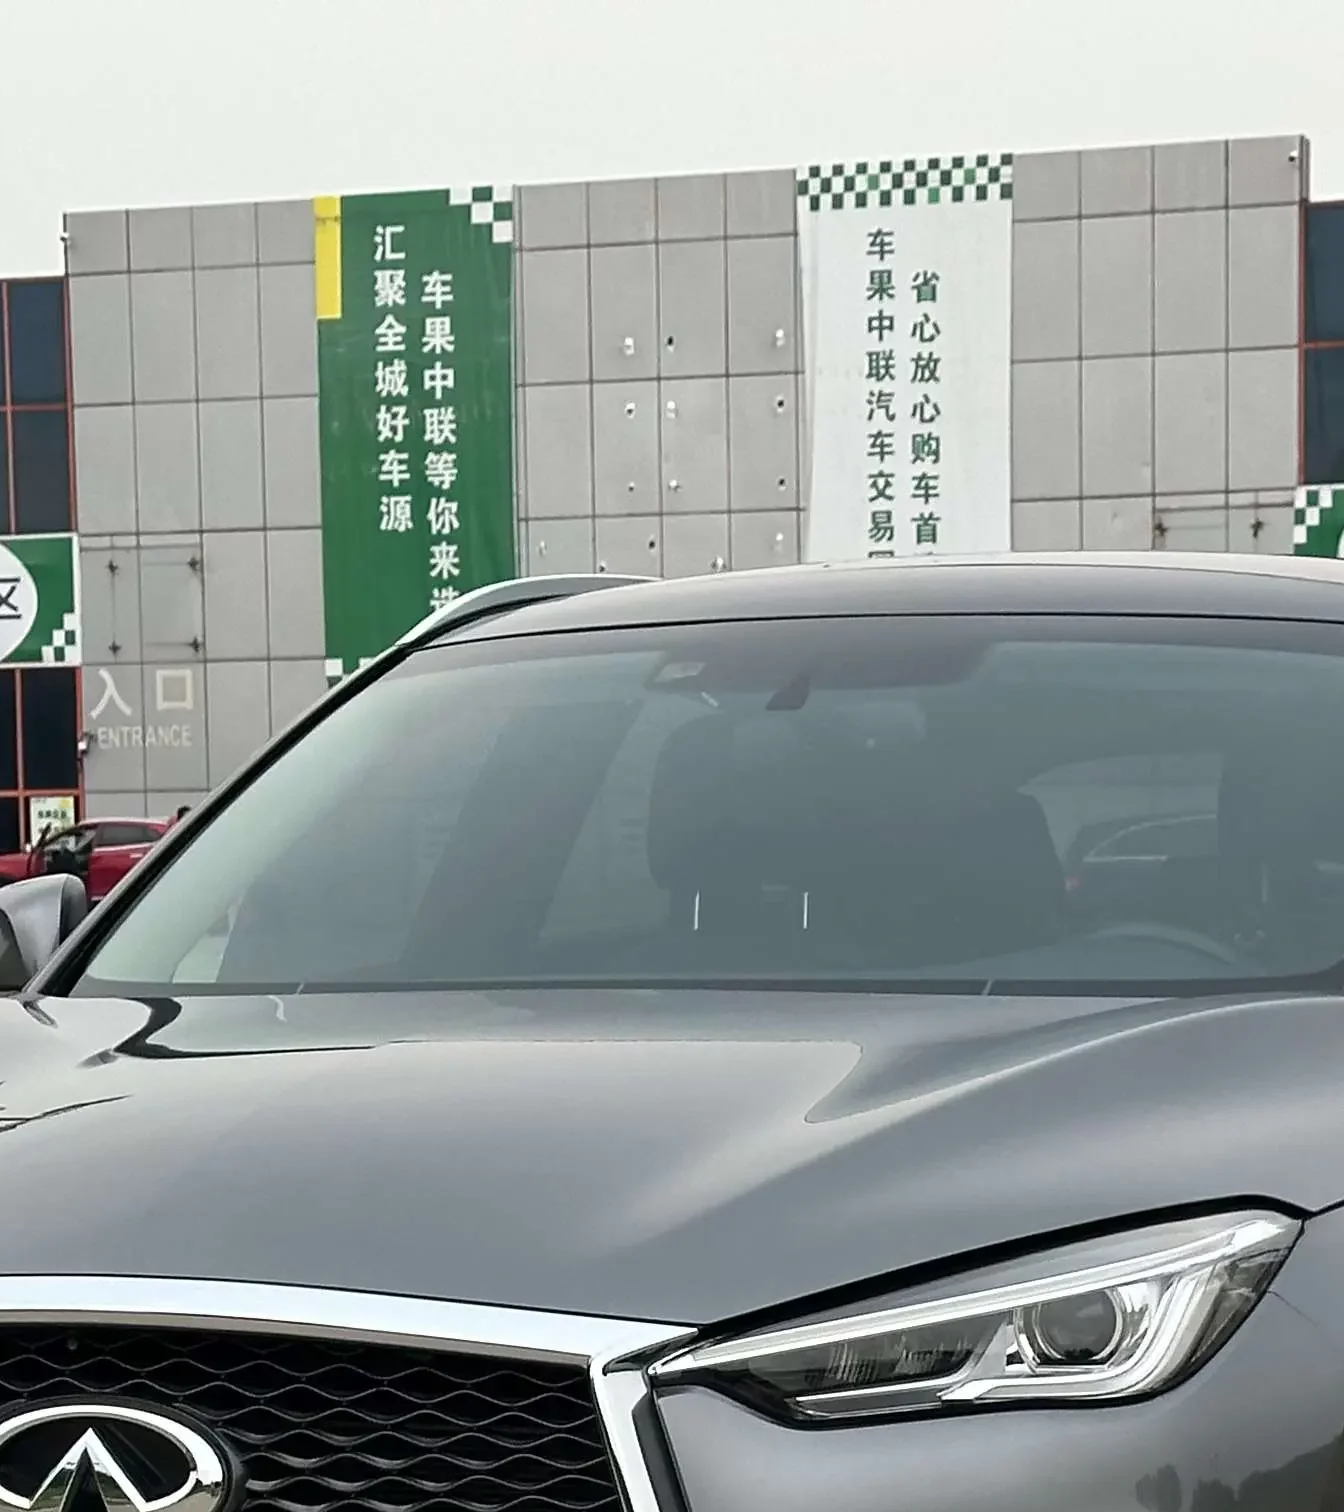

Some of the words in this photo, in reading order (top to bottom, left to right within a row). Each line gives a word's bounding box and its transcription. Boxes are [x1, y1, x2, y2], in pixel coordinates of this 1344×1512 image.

[373, 225, 414, 533] 汇聚全城好车源
[864, 228, 897, 558] 车果中联汽车交易
[908, 270, 943, 556] 省心放心购车首
[89, 667, 195, 720] 入口
[96, 723, 195, 750] ENTRANCE
